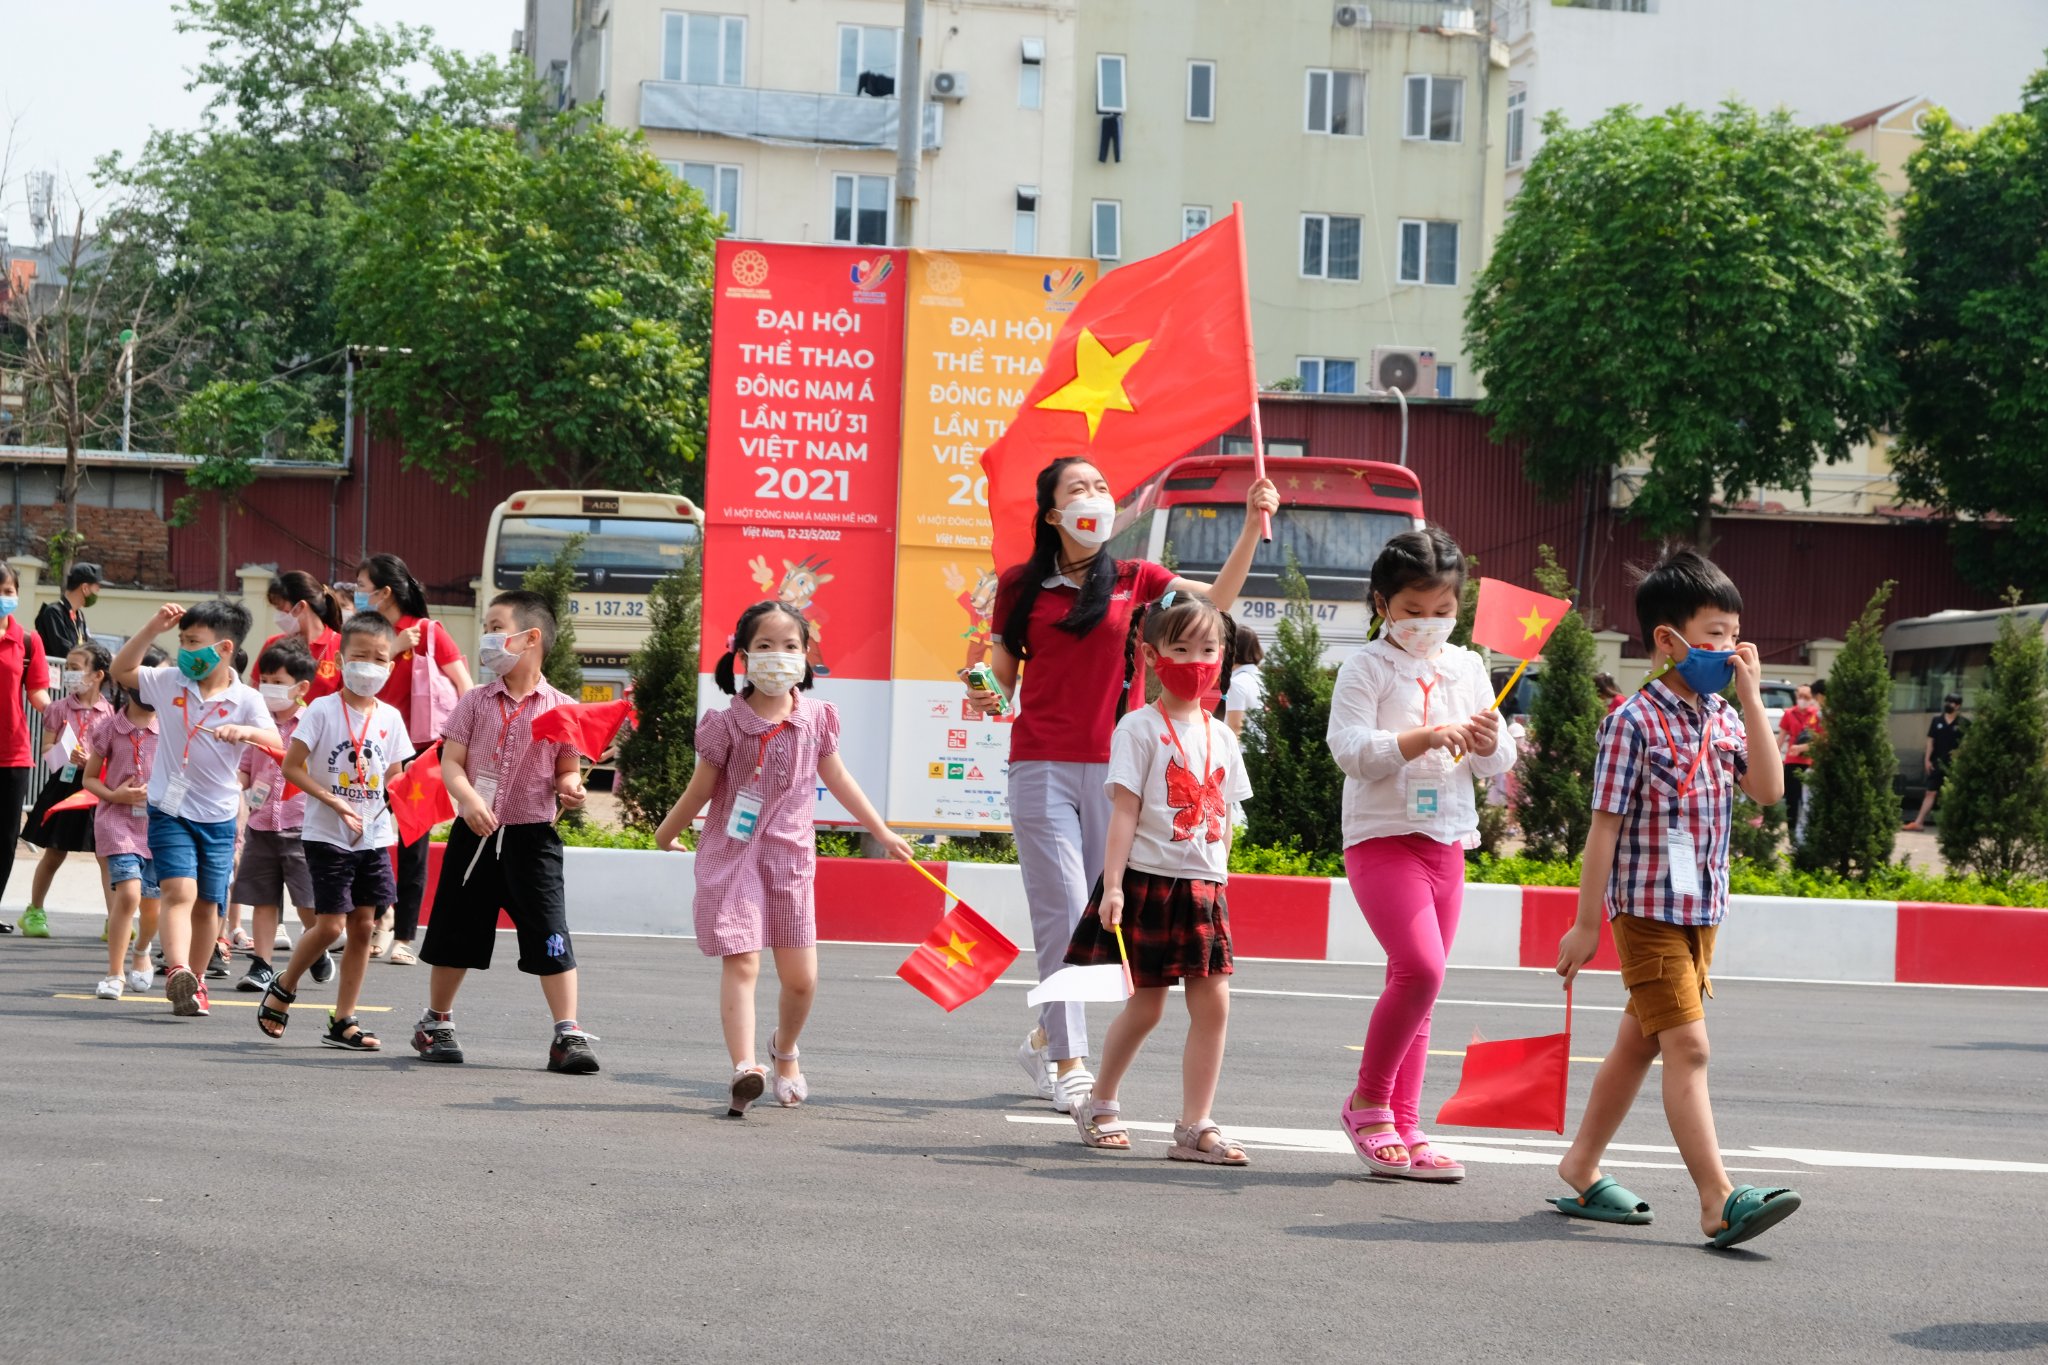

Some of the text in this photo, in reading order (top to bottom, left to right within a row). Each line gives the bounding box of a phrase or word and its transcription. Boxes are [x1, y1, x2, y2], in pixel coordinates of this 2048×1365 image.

[756, 308, 861, 337] ĐẠI HỘI
[950, 316, 1052, 345] ĐẠI HỘI
[738, 339, 875, 369] THỂ THAO
[932, 346, 1045, 375] THỂ THA
[736, 372, 875, 402] ĐÔNG NAM Á
[929, 380, 1026, 408] ĐÔNG NA
[740, 403, 868, 434] LẦN THỨ 31
[933, 411, 979, 438] LẦN
[739, 434, 868, 463] VIỆT NAM
[754, 466, 849, 502] 2021
[592, 502, 619, 510] AERO
[723, 507, 733, 517] VÌ
[734, 507, 753, 519] MỘT
[754, 508, 782, 520] ĐÔNG
[783, 511, 804, 521] NAM
[805, 510, 813, 521] Á
[813, 512, 841, 523] MẠNH
[857, 513, 878, 524] HƠN
[742, 526, 841, 541] Việt Nam, 12-23/5/2022
[595, 601, 643, 616] 137.32
[1243, 601, 1338, 621] 29B-0147
